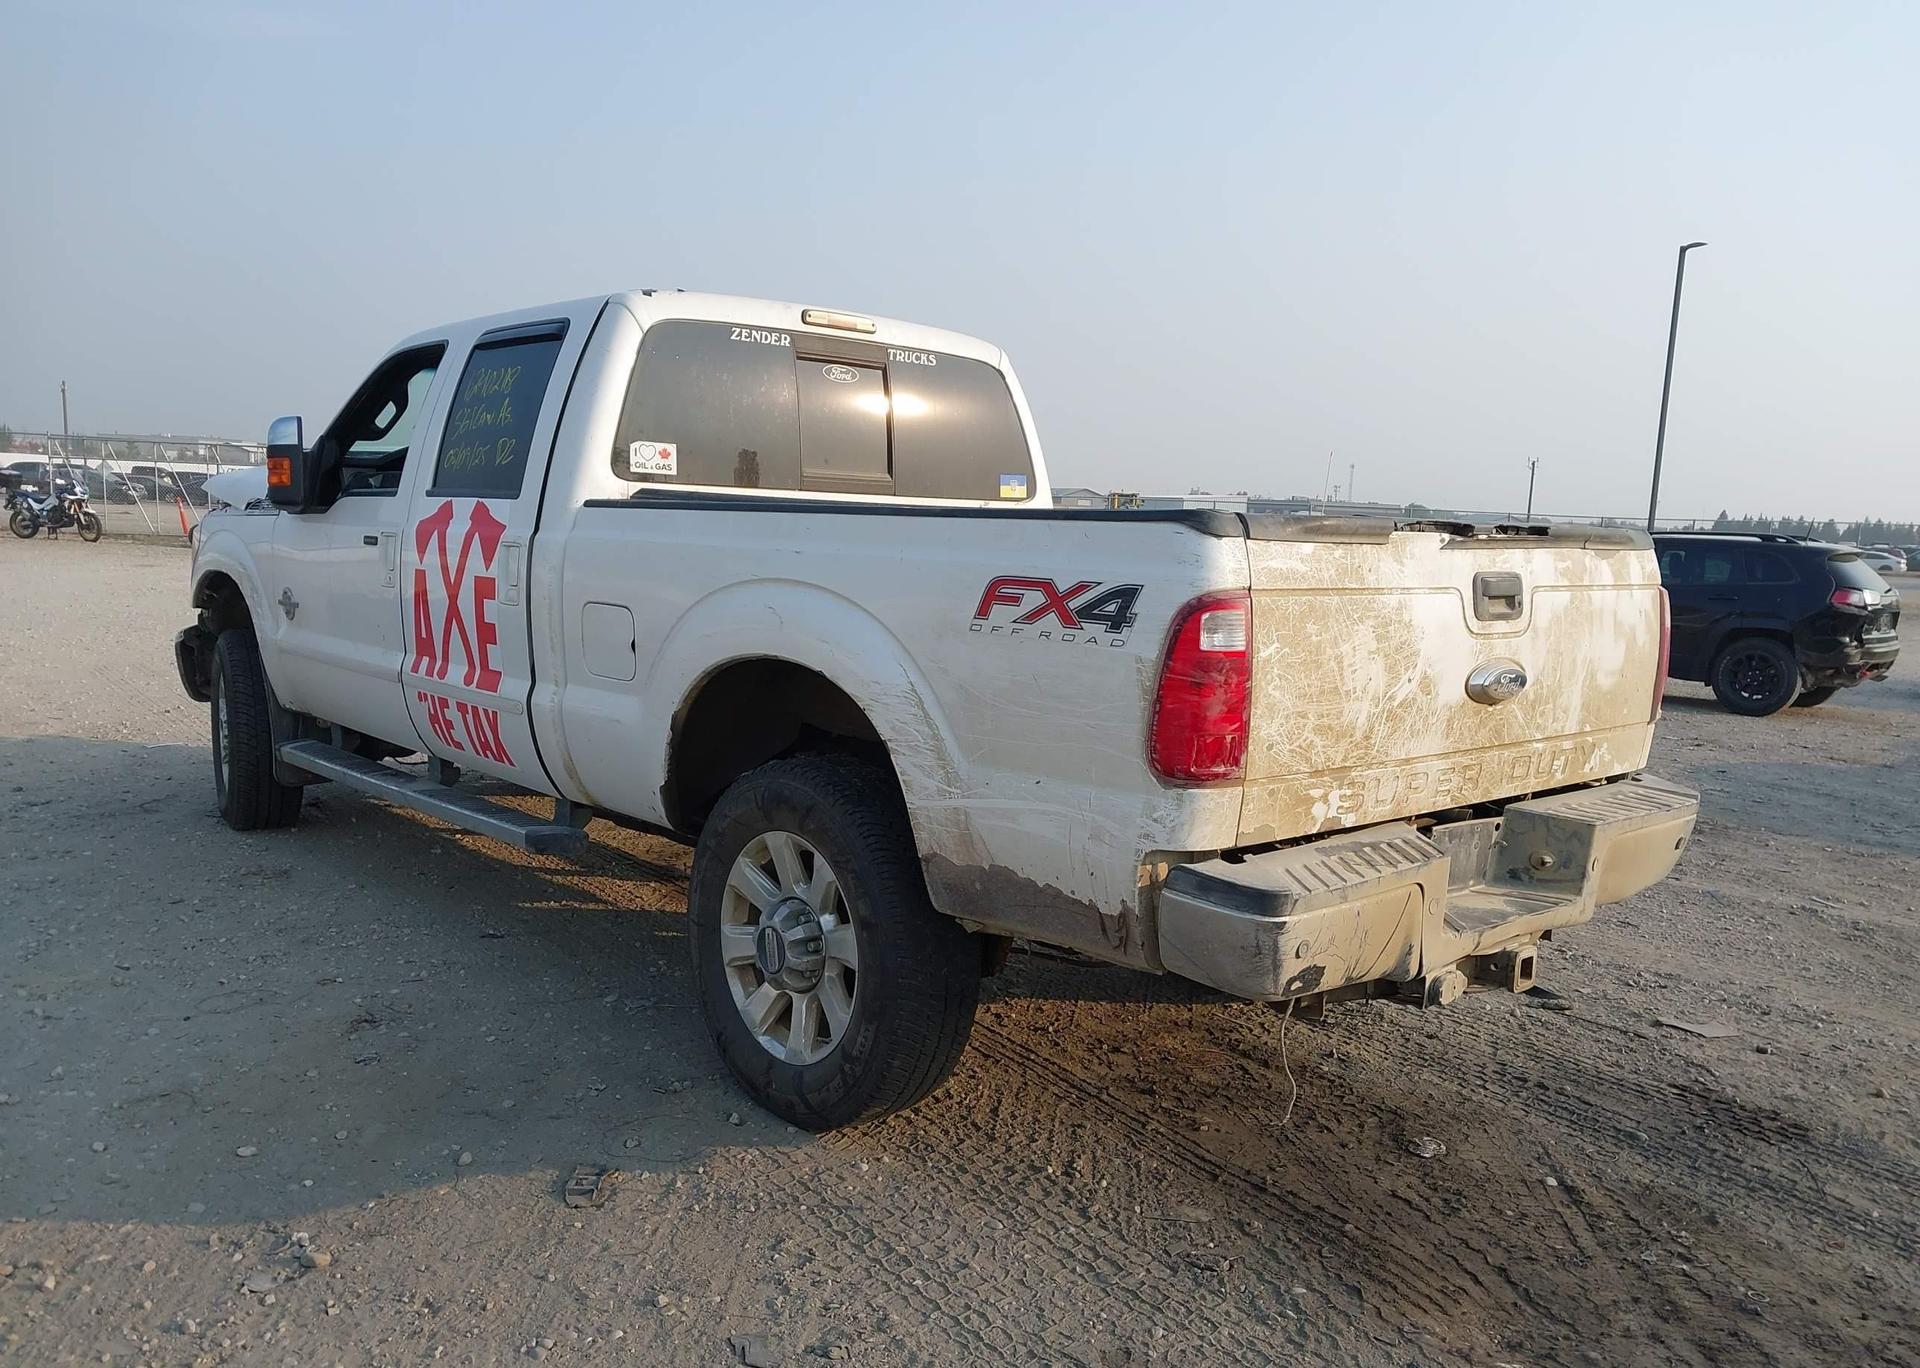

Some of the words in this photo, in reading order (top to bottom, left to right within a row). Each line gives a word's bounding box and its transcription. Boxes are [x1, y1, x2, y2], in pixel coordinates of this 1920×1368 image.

[730, 327, 791, 347] ZENDER
[888, 349, 937, 366] TRUCKS
[634, 461, 649, 470] OIL
[655, 462, 673, 471] GAS
[410, 499, 507, 694] AXE
[974, 575, 1145, 634] FX4
[1038, 631, 1125, 648] ROAD
[417, 690, 466, 752] HE
[455, 700, 517, 768] TAX
[1336, 763, 1483, 815] SUPER
